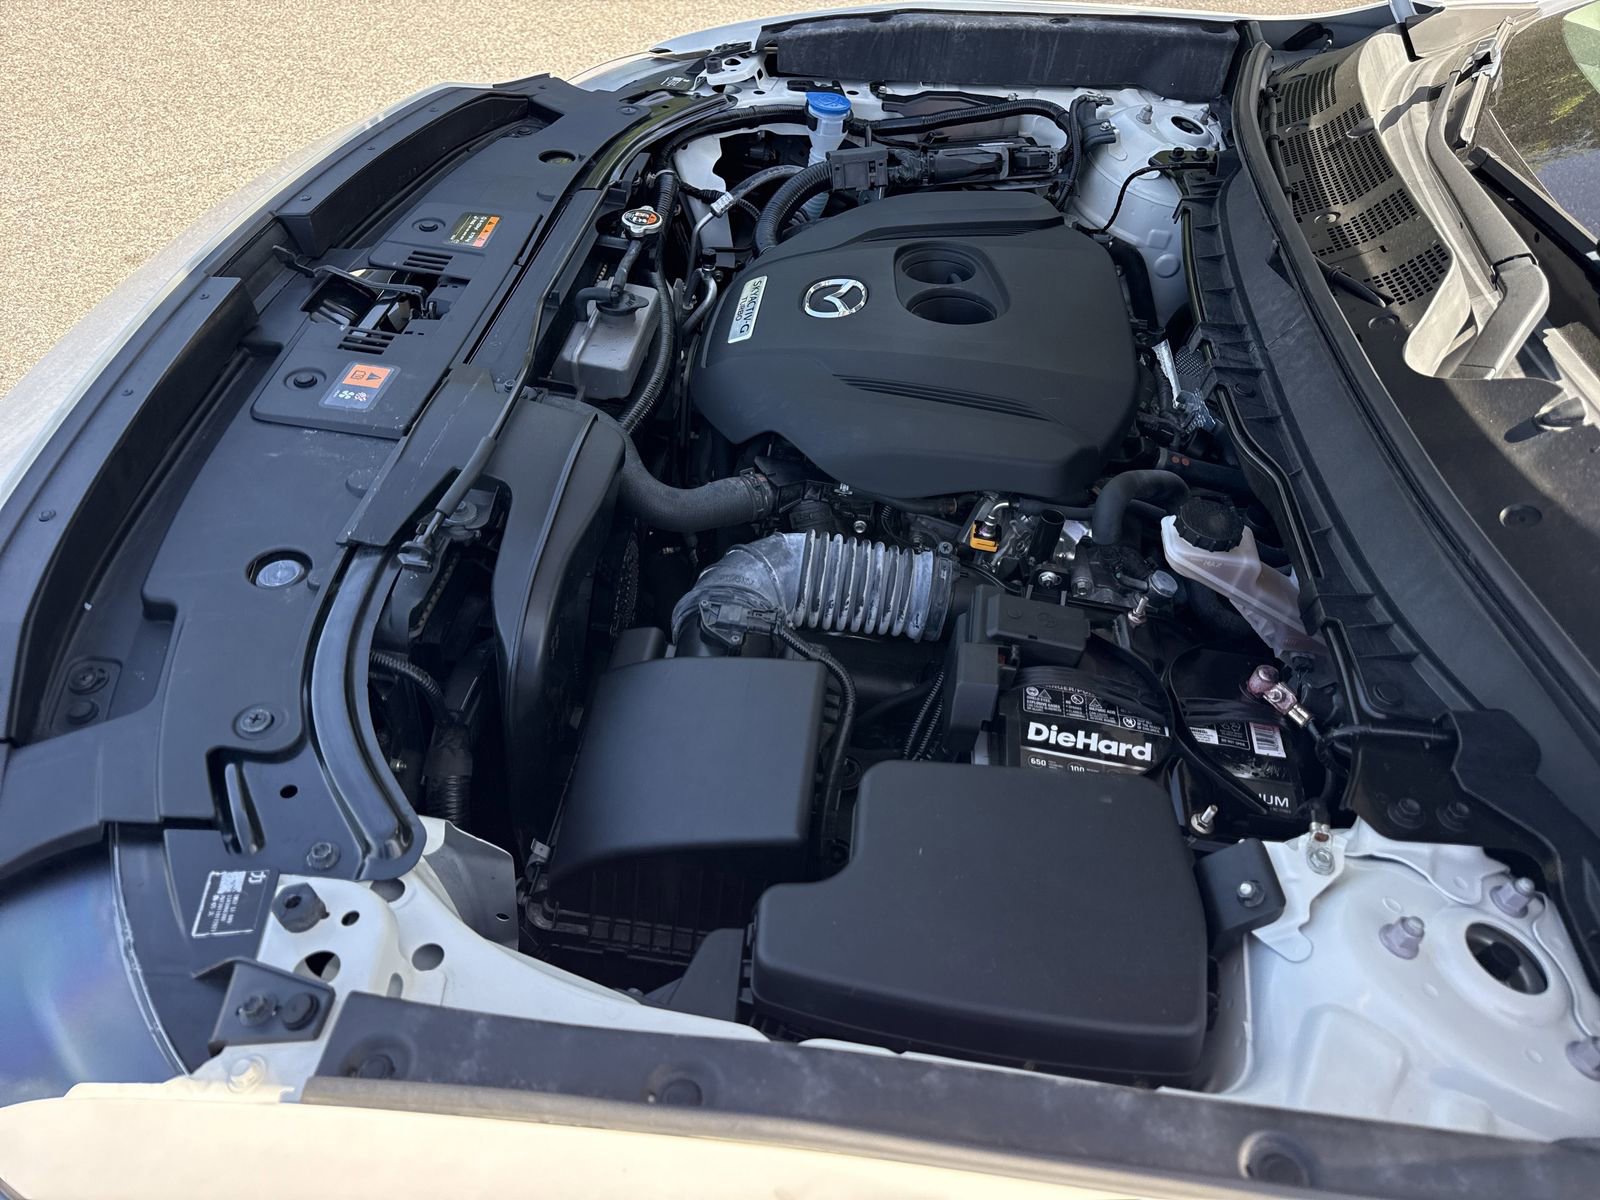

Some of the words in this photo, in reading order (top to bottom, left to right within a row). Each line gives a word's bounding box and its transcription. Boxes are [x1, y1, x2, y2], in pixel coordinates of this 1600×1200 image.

[736, 296, 748, 322] TURBO
[740, 280, 762, 334] SKYACTIV-G
[1027, 721, 1152, 761] DieHard
[1030, 757, 1047, 767] 650
